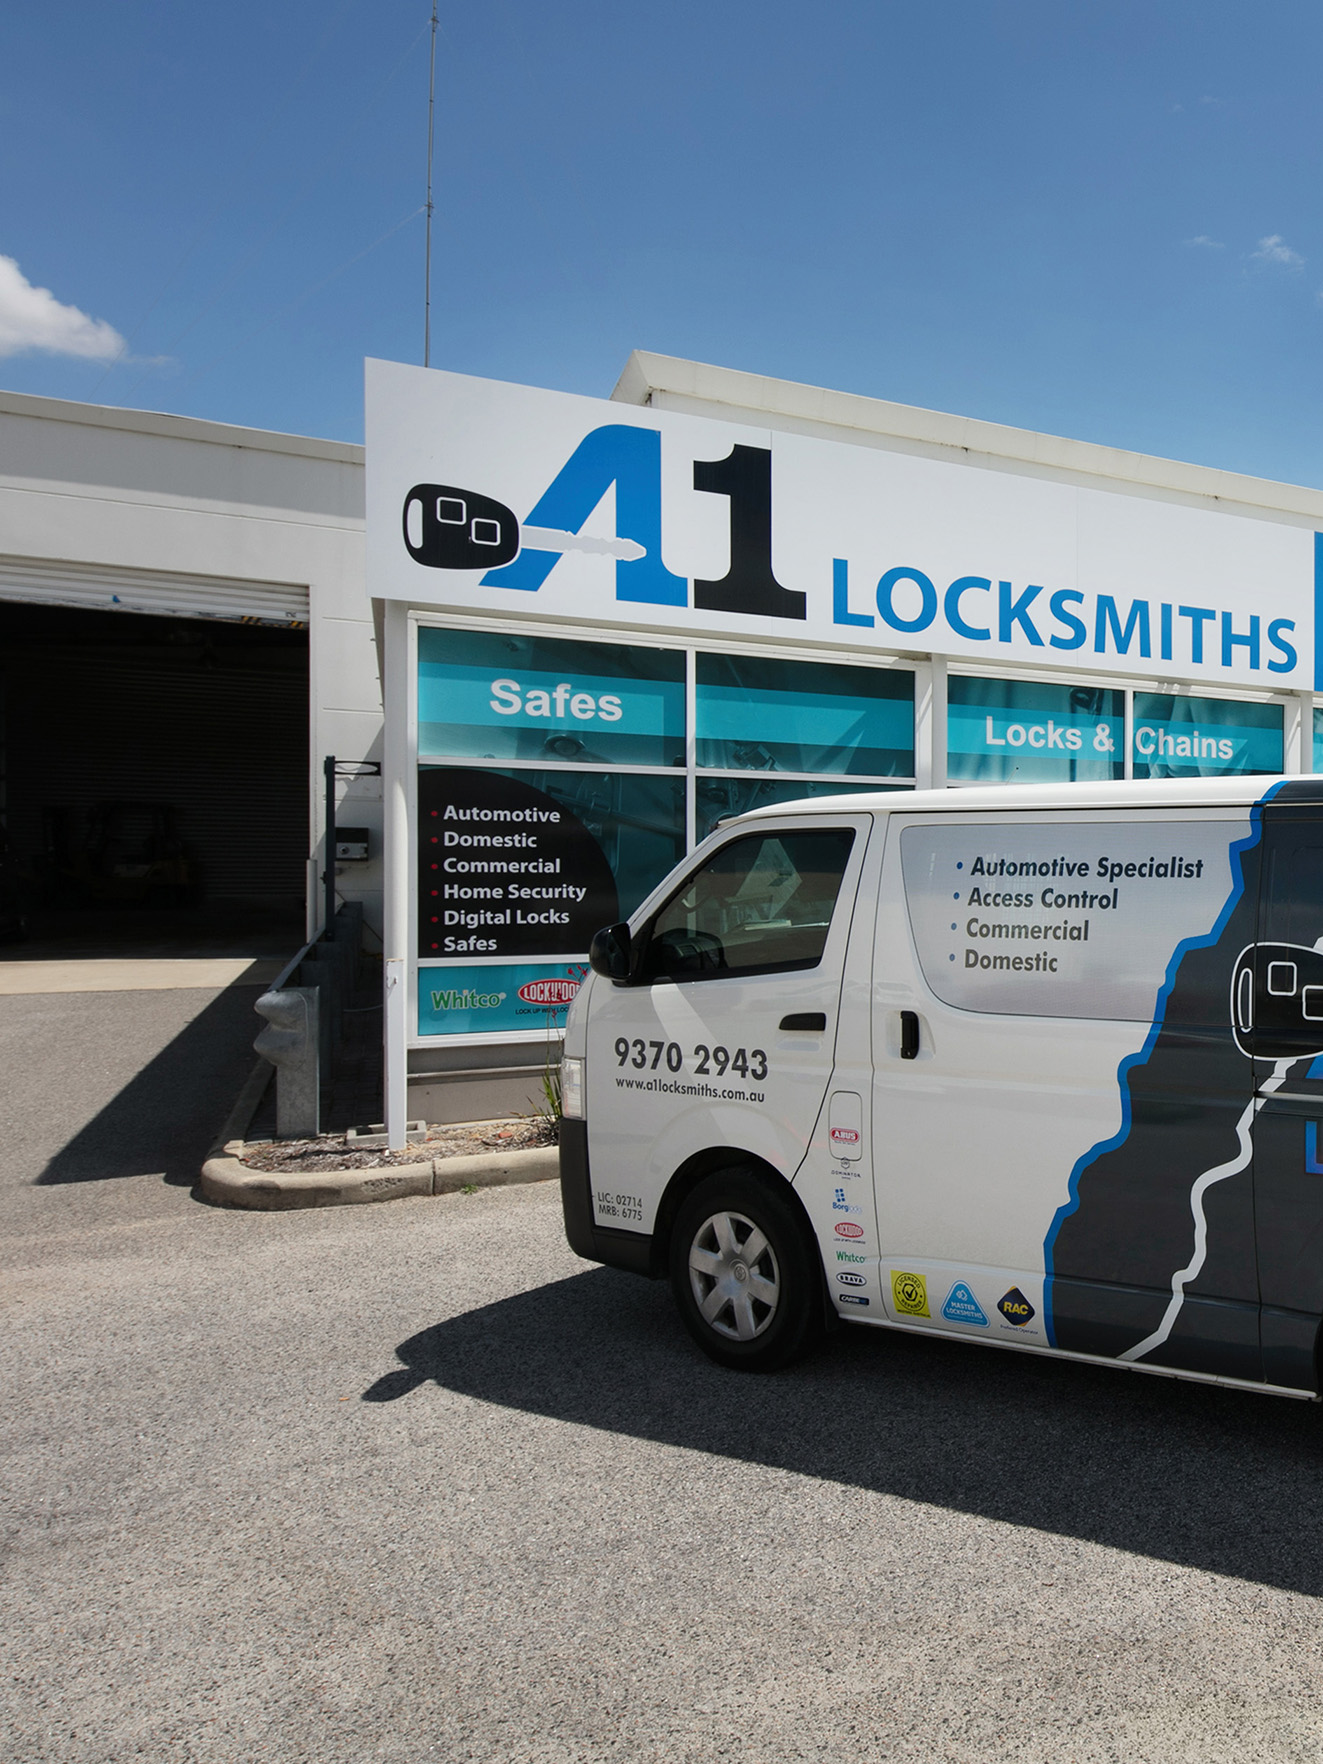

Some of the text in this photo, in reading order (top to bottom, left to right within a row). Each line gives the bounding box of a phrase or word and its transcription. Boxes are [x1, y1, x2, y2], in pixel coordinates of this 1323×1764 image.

[479, 424, 1298, 674] A1 LOCKSMITHS
[489, 678, 623, 722] Safes
[985, 716, 1234, 760] Locks & Chains
[443, 805, 561, 823] Automotive
[444, 831, 537, 848] Domestic
[443, 857, 561, 873] Commercial
[970, 856, 1204, 883] Automotive Specialist
[444, 883, 587, 902] Home Security
[967, 887, 1118, 909] Access Control
[444, 908, 570, 929] Digital Locks
[966, 917, 1089, 941] Commercial
[444, 935, 498, 952] Safes
[964, 949, 1058, 973] Domestic
[431, 989, 501, 1010] Whitco
[515, 1007, 532, 1015] LOCK
[615, 1037, 768, 1081] 9370 2943
[615, 1077, 765, 1103] www.a1locksmiths.com.au
[597, 1191, 643, 1208] LIC: 02714
[599, 1203, 643, 1221] MRB: 6775
[945, 1308, 983, 1319] LOCKSMITHS
[951, 1302, 976, 1311] MASTER
[1003, 1302, 1029, 1315] RAC
